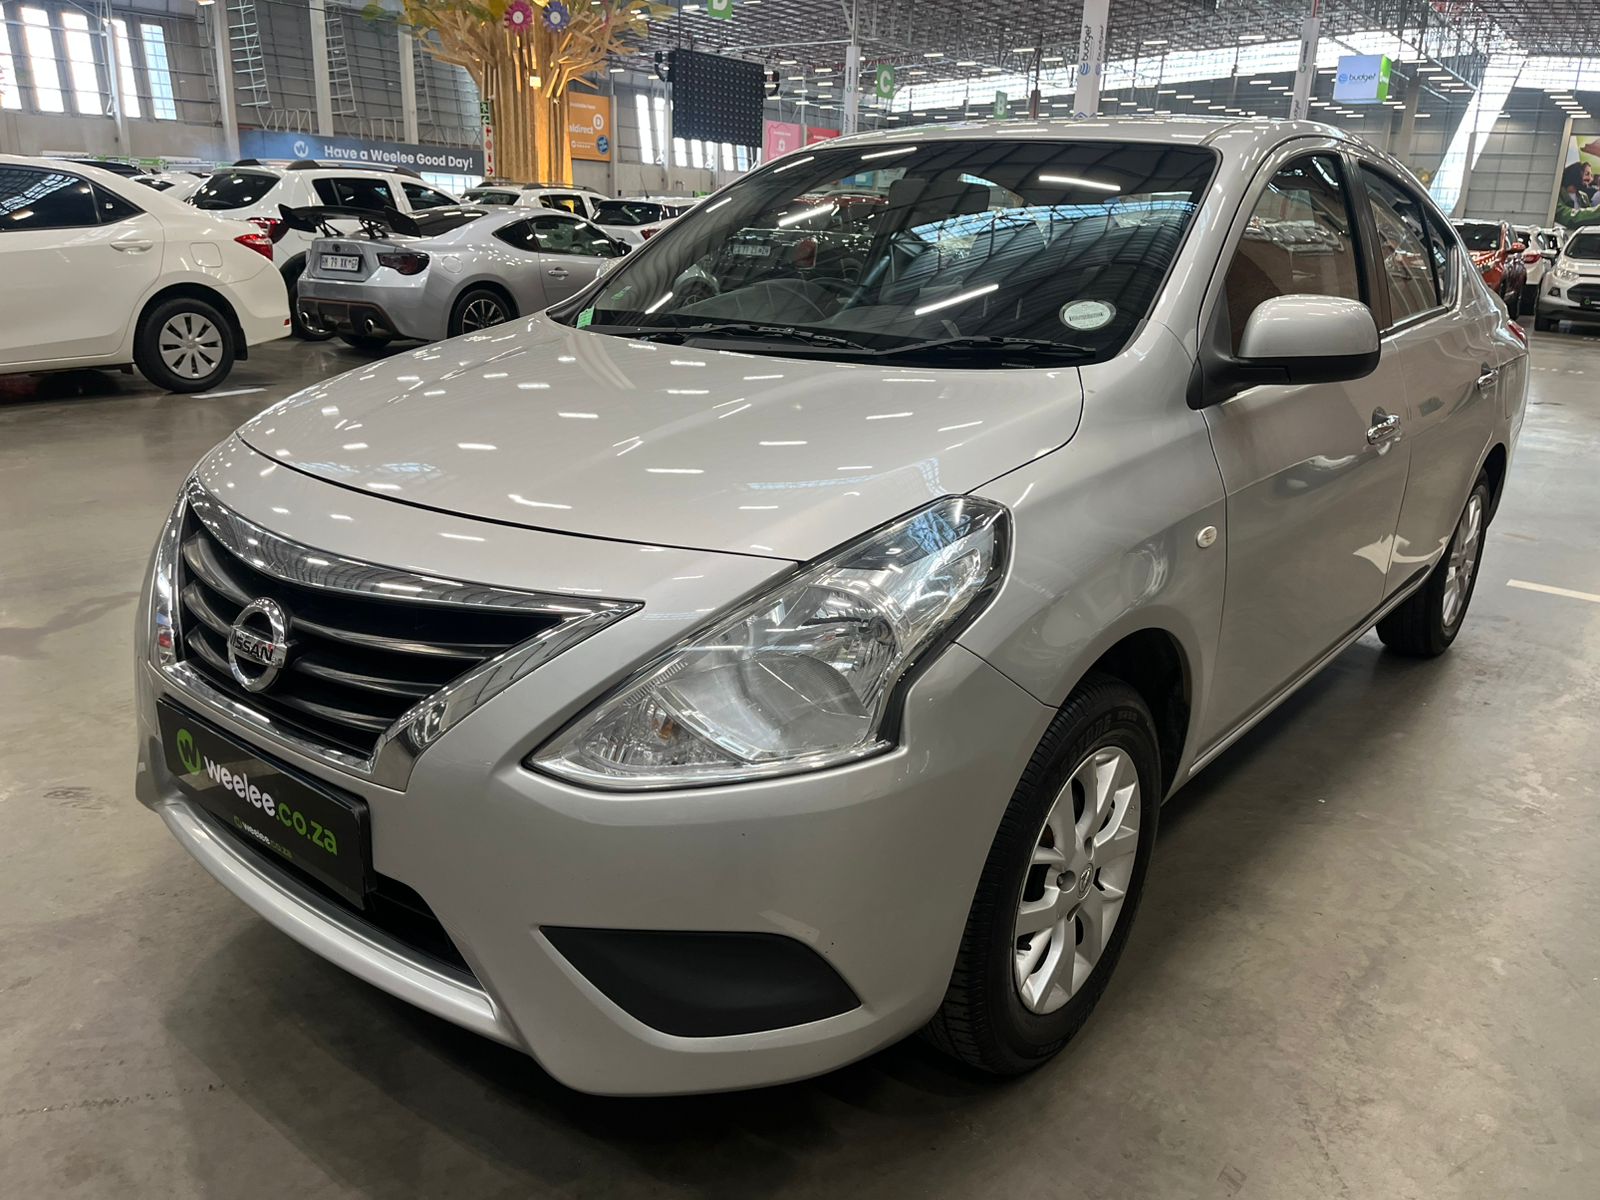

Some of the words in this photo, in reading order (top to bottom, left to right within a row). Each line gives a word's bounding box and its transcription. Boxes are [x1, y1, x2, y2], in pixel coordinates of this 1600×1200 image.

[1083, 25, 1093, 61] budget
[879, 70, 891, 93] C
[1348, 73, 1376, 83] budget
[997, 94, 1005, 115] B
[324, 145, 357, 160] Have
[359, 149, 368, 160] a
[370, 149, 415, 164] Weelee
[416, 153, 446, 167] Good
[448, 155, 473, 171] Day!
[204, 756, 338, 856] weelee.co.za
